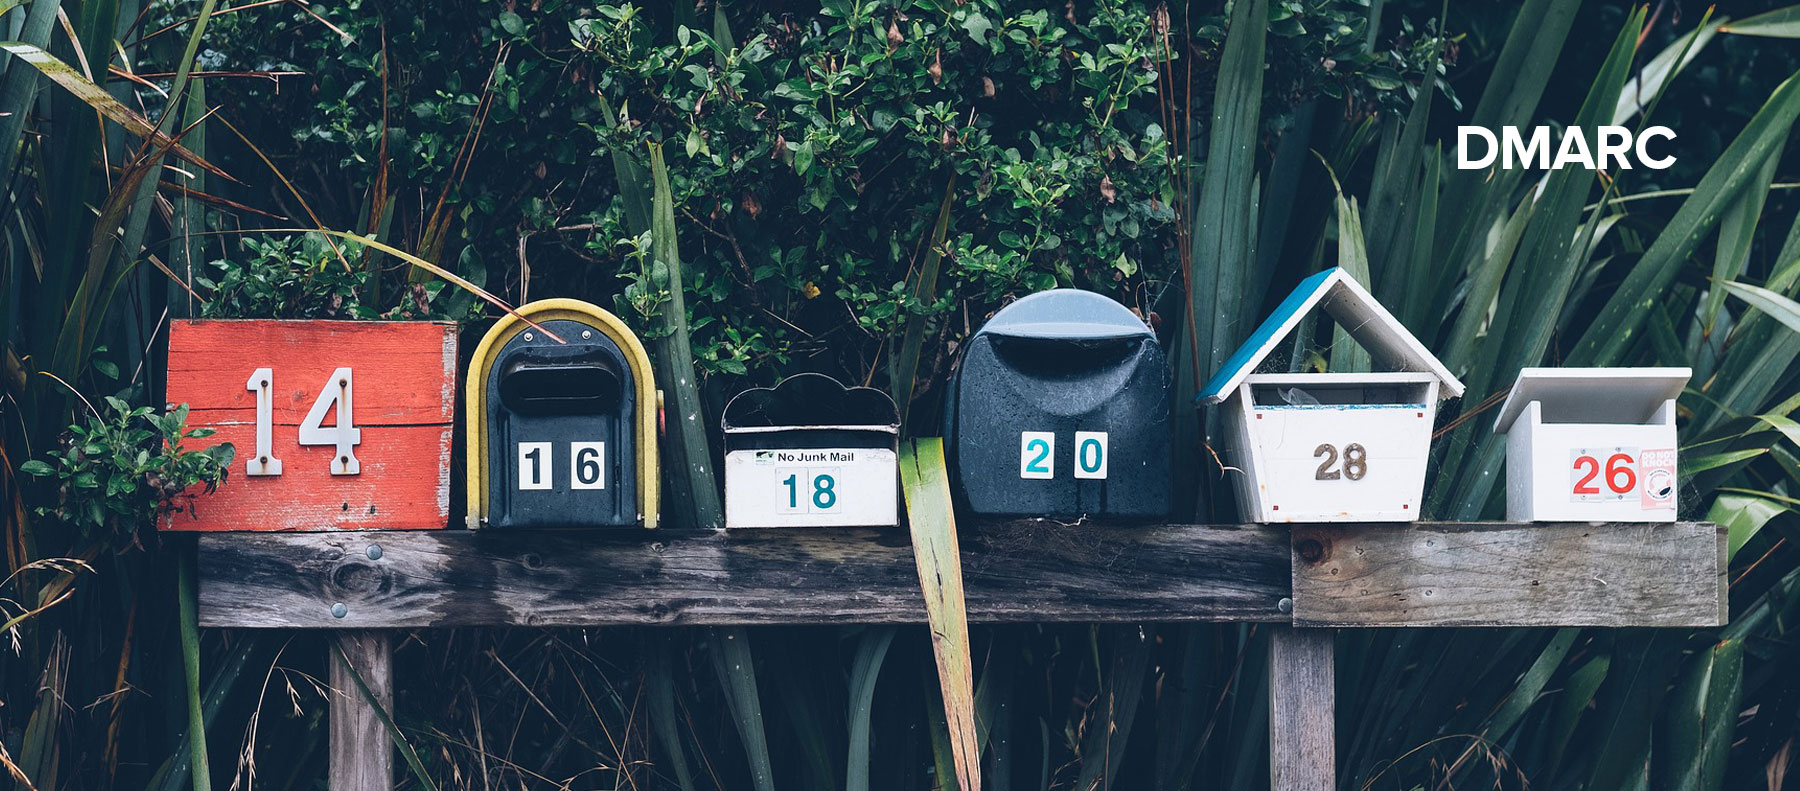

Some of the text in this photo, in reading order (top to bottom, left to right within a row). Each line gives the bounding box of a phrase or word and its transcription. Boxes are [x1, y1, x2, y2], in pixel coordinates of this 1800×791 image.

[246, 367, 361, 476] 14
[778, 452, 795, 462] No
[797, 452, 827, 462] Junk
[830, 452, 854, 462] Mail
[1313, 442, 1368, 481] 28
[1573, 453, 1637, 494] 26
[783, 474, 837, 509] 18
